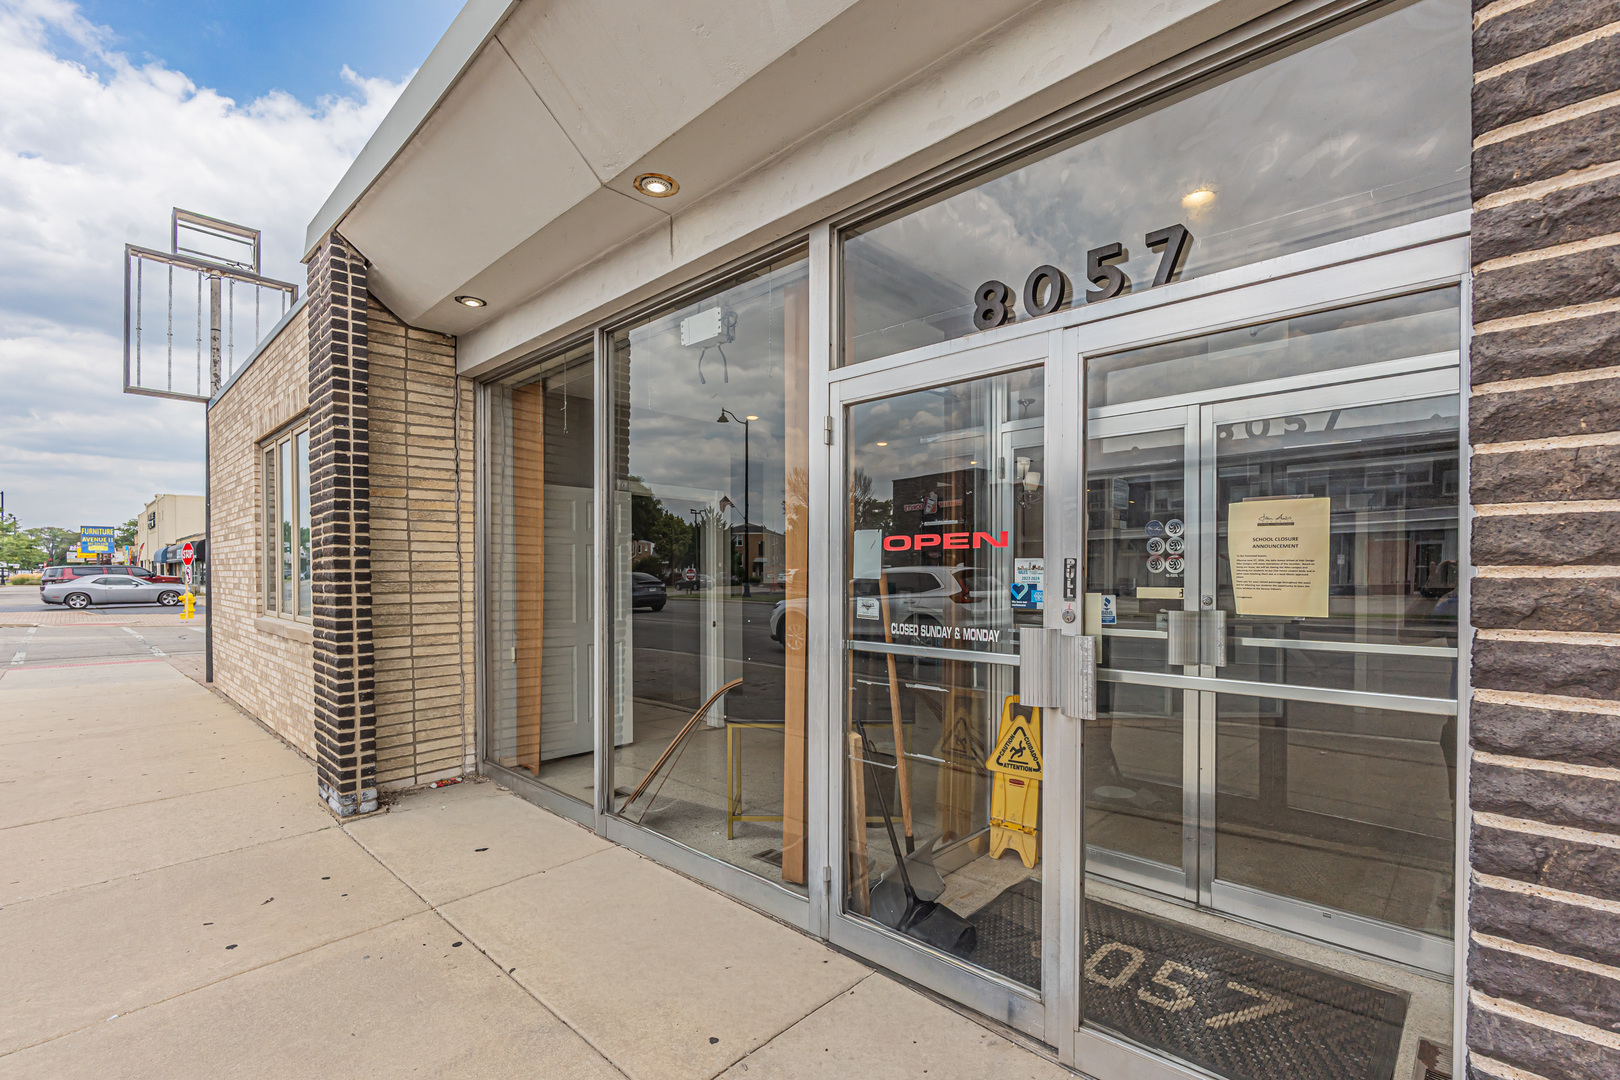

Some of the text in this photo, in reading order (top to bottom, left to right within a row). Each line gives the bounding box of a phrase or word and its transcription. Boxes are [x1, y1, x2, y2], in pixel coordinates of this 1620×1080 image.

[973, 223, 1189, 331] 8057
[81, 527, 114, 536] FURNITURE
[883, 531, 1009, 551] OPEN
[182, 549, 193, 559] STOP
[1065, 558, 1076, 597] PULL
[891, 622, 1000, 643] CLOSED SUNDAY & MONDAY
[999, 734, 1016, 757] CAUTION
[1023, 737, 1039, 762] CUIDADO
[1003, 763, 1033, 773] ATTENTION
[1085, 942, 1295, 1028] 057
